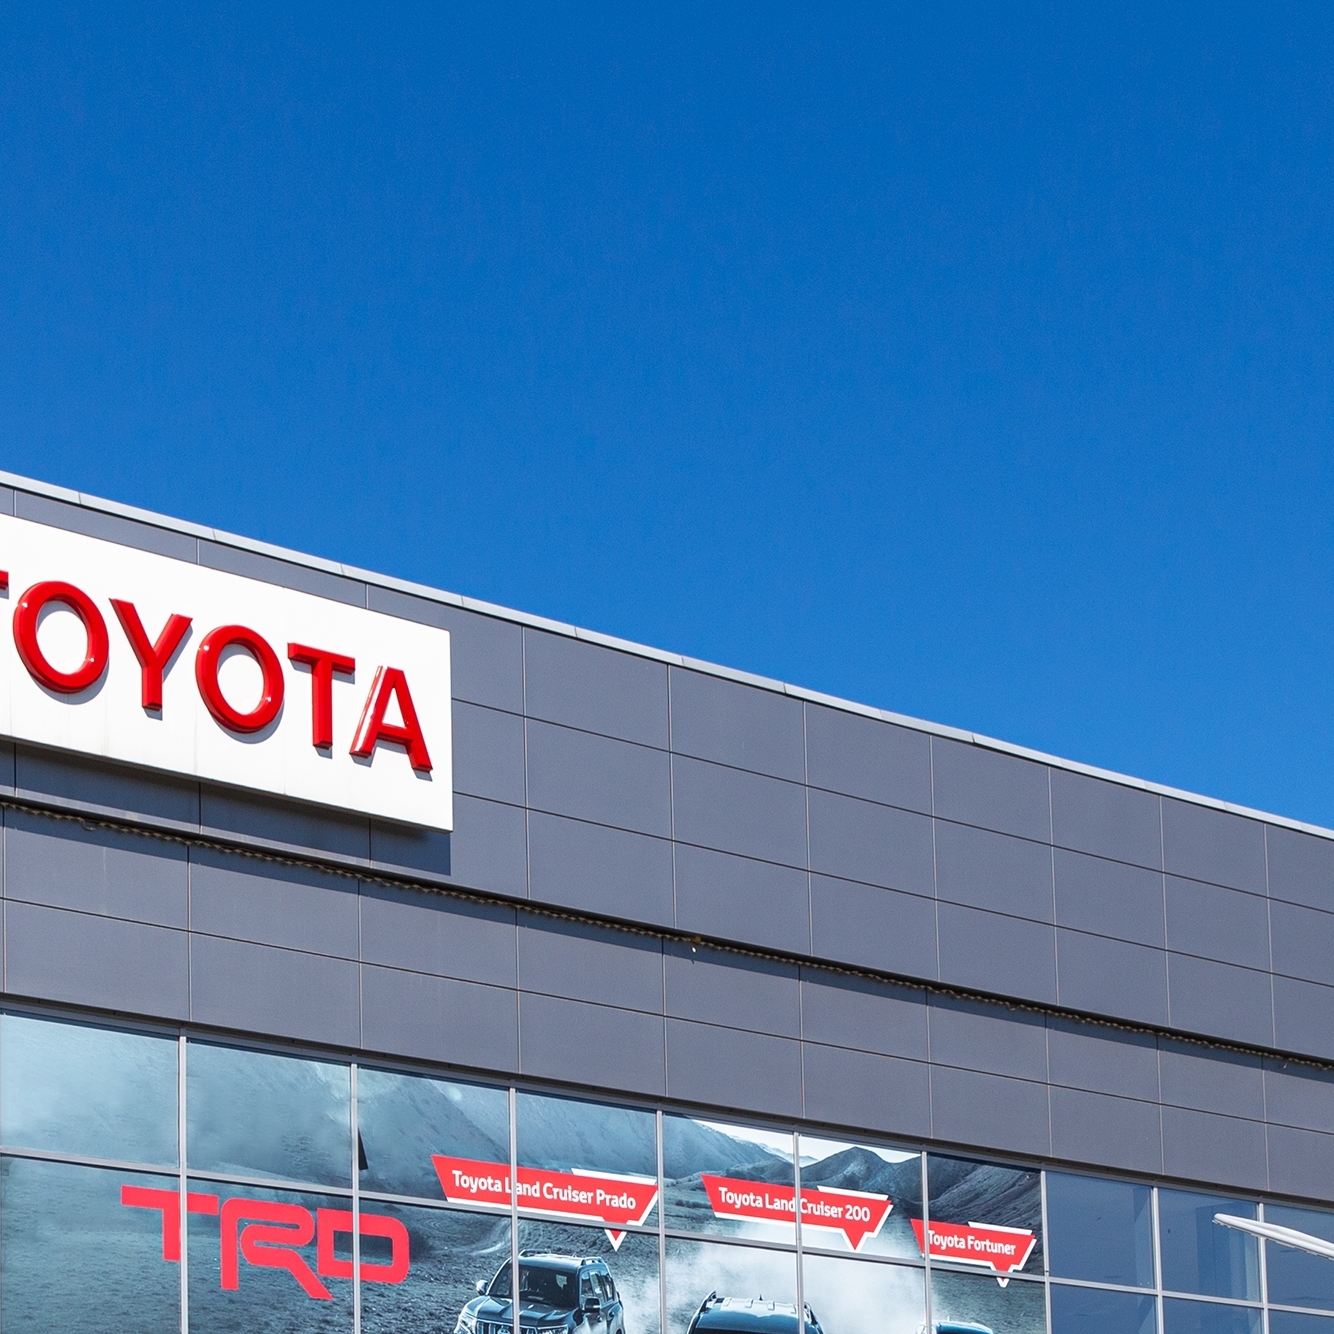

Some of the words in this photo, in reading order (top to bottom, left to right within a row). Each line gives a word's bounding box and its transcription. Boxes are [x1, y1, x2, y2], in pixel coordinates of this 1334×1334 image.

[451, 1170, 500, 1194] Toyota
[505, 1176, 540, 1198] Land
[543, 1182, 593, 1204] Cruiser
[596, 1188, 636, 1210] Prado
[718, 1186, 763, 1209] Toyota
[765, 1192, 797, 1213] Land
[800, 1198, 843, 1219] Cruiser
[845, 1204, 871, 1223] 200
[121, 1185, 410, 1300] TRD
[928, 1229, 966, 1251] Toyota
[967, 1234, 1016, 1256] Fortuner
